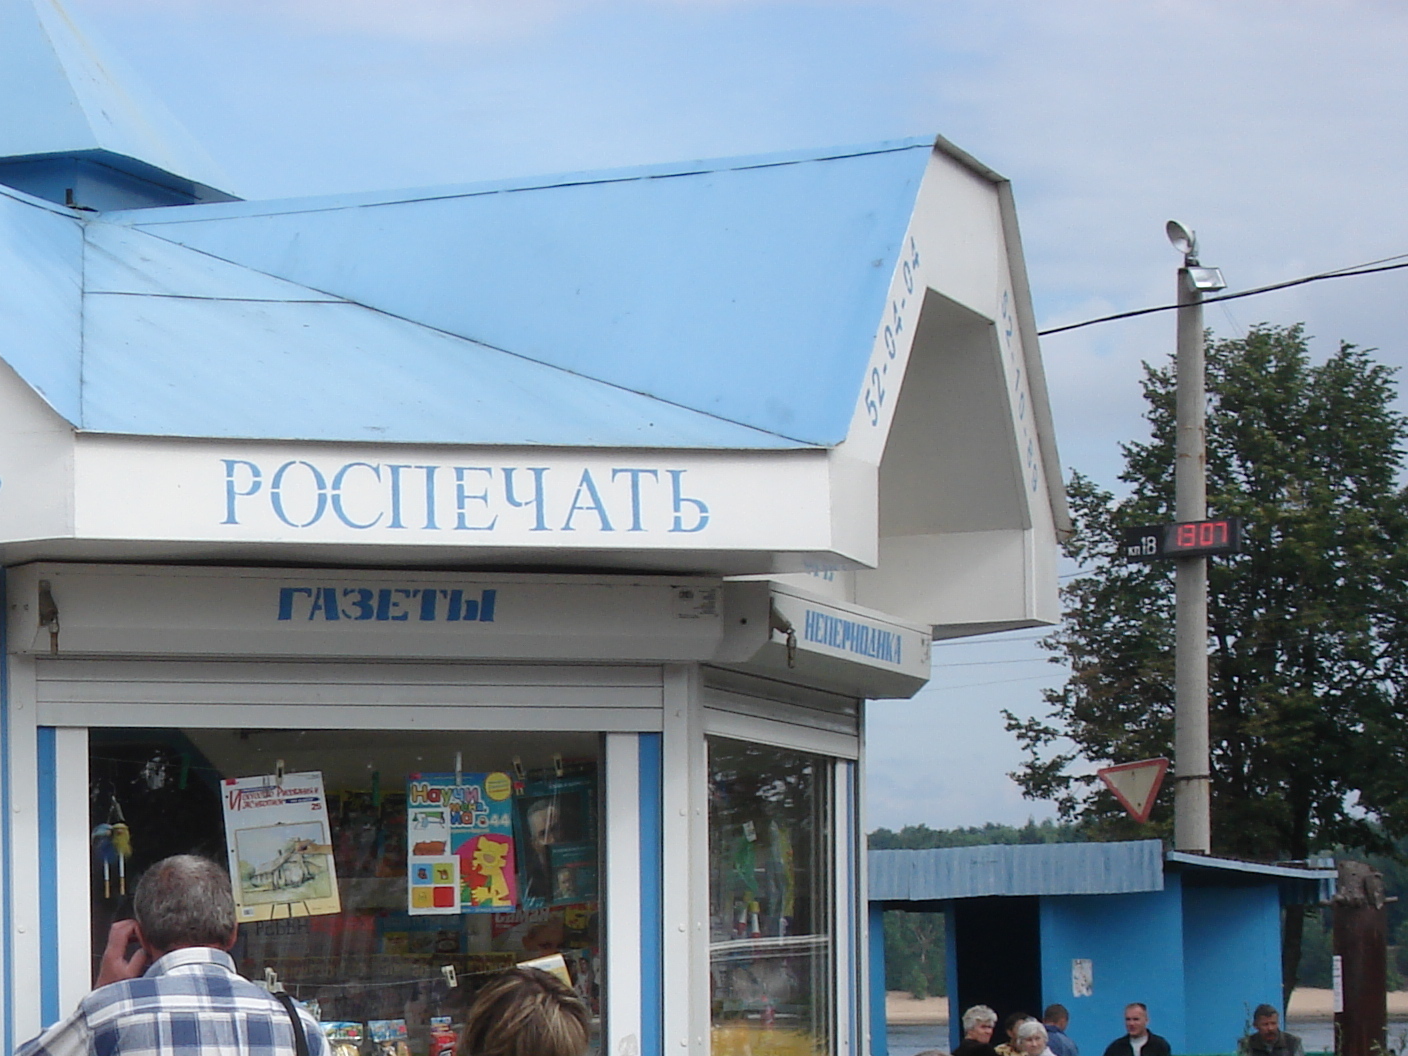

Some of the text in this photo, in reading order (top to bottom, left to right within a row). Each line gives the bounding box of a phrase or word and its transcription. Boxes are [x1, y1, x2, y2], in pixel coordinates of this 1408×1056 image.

[865, 236, 920, 427] 52-04-04
[220, 458, 710, 533] РОСПЕЧАТЬ
[277, 586, 497, 622] ГАЗЕТЫ
[804, 609, 901, 665] НЕПЕРИОДИКА
